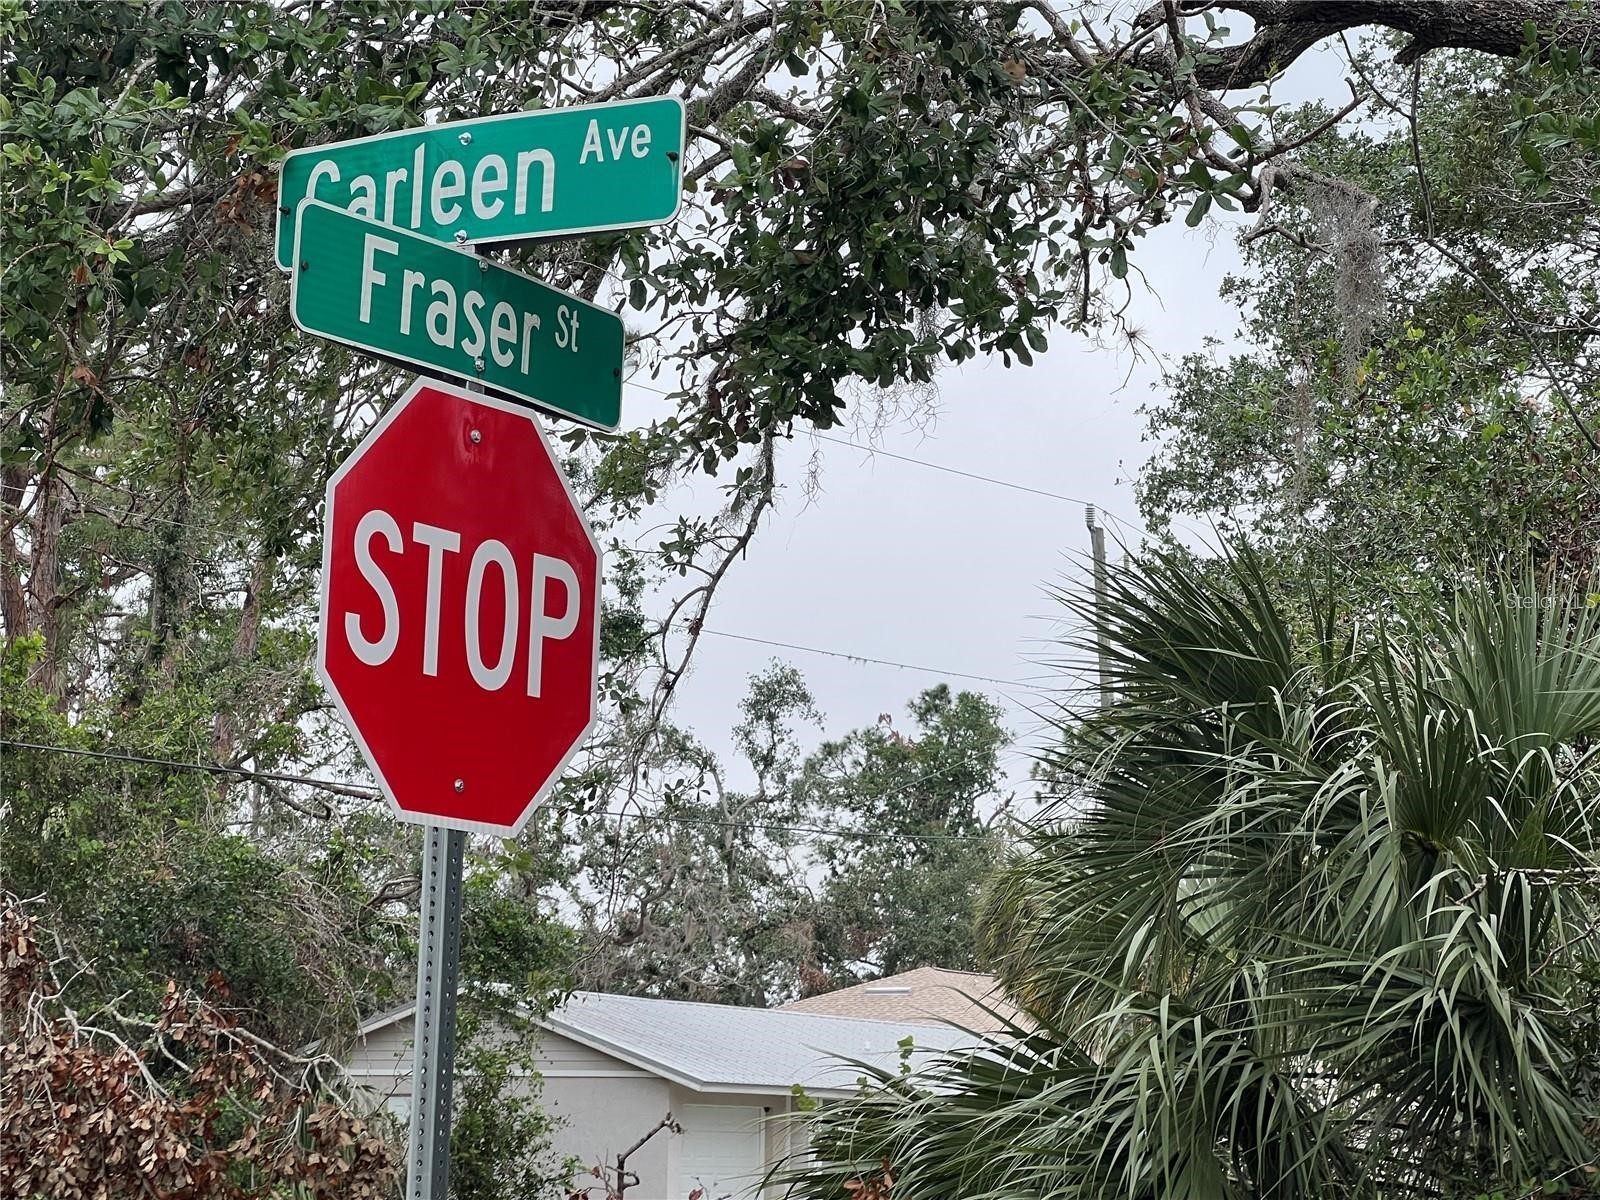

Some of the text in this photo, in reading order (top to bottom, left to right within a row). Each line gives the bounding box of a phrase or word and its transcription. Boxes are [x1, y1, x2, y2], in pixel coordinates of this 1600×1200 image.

[579, 118, 652, 165] Ave
[359, 232, 580, 375] Fraser St
[344, 509, 581, 699] STOP
